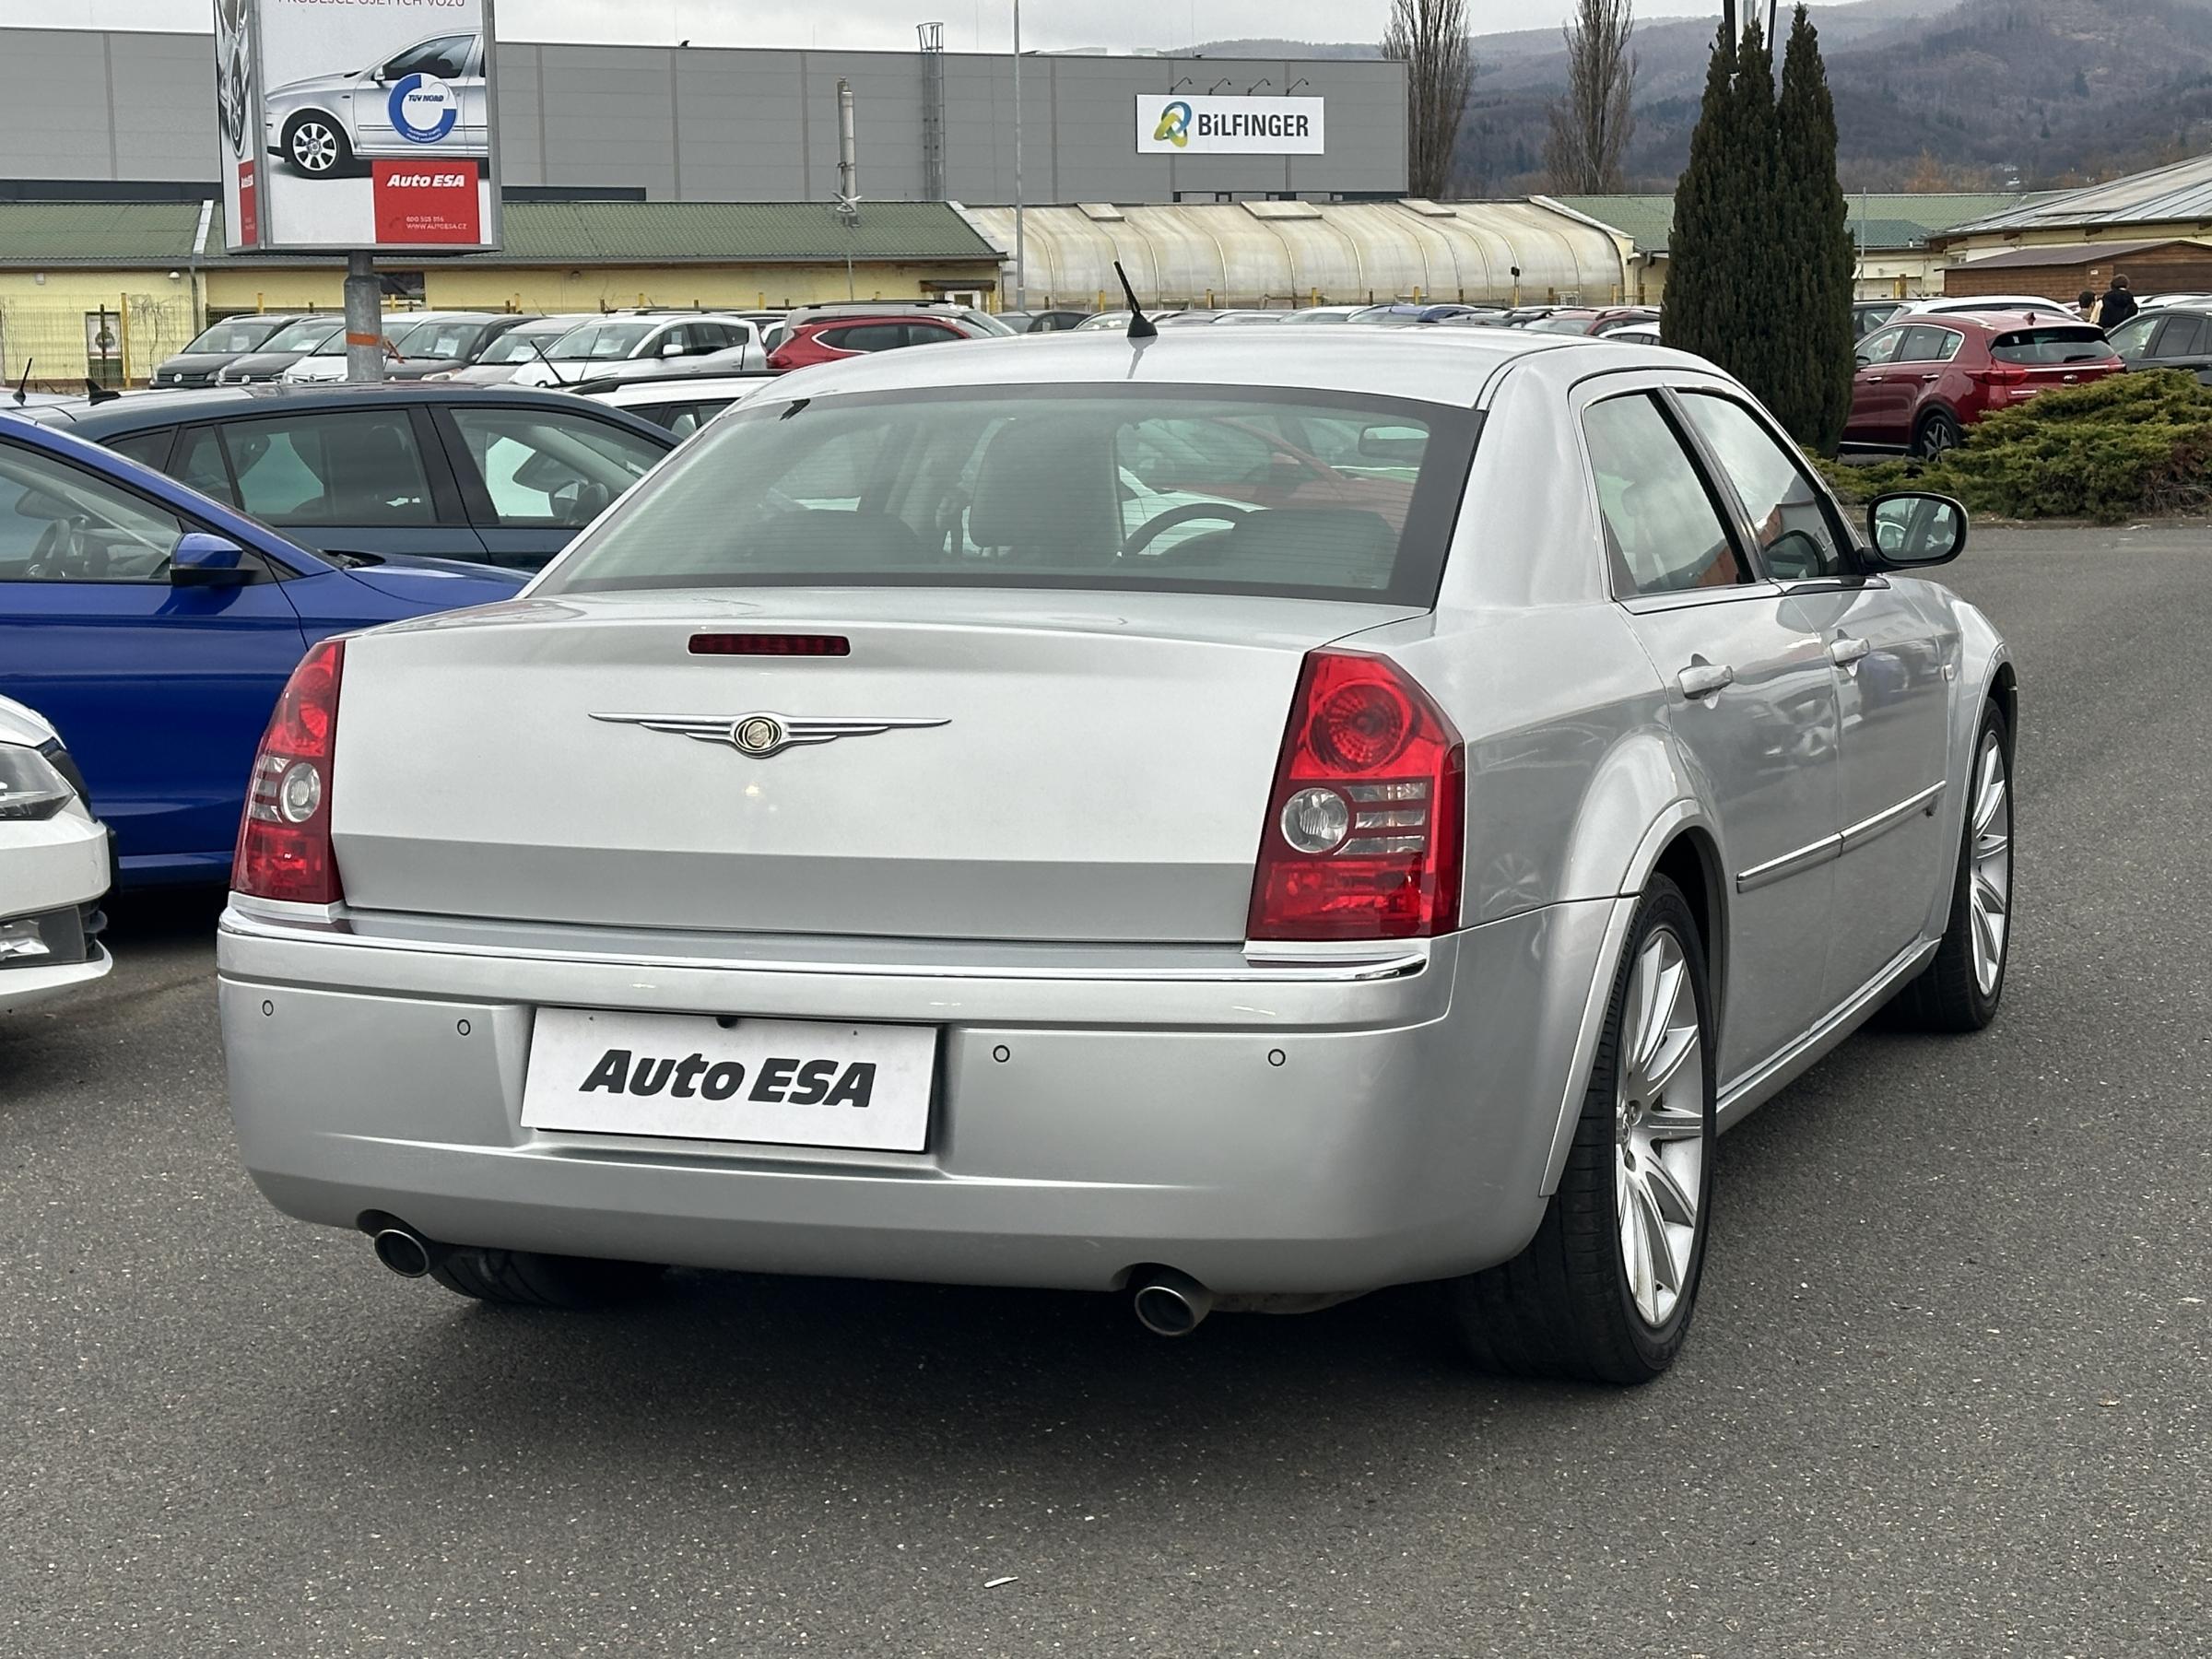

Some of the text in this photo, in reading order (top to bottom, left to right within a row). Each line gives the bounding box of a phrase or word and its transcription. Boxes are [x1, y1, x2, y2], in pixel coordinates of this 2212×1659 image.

[387, 174, 465, 187] Auto ESA
[579, 1049, 877, 1107] Auto ESA
